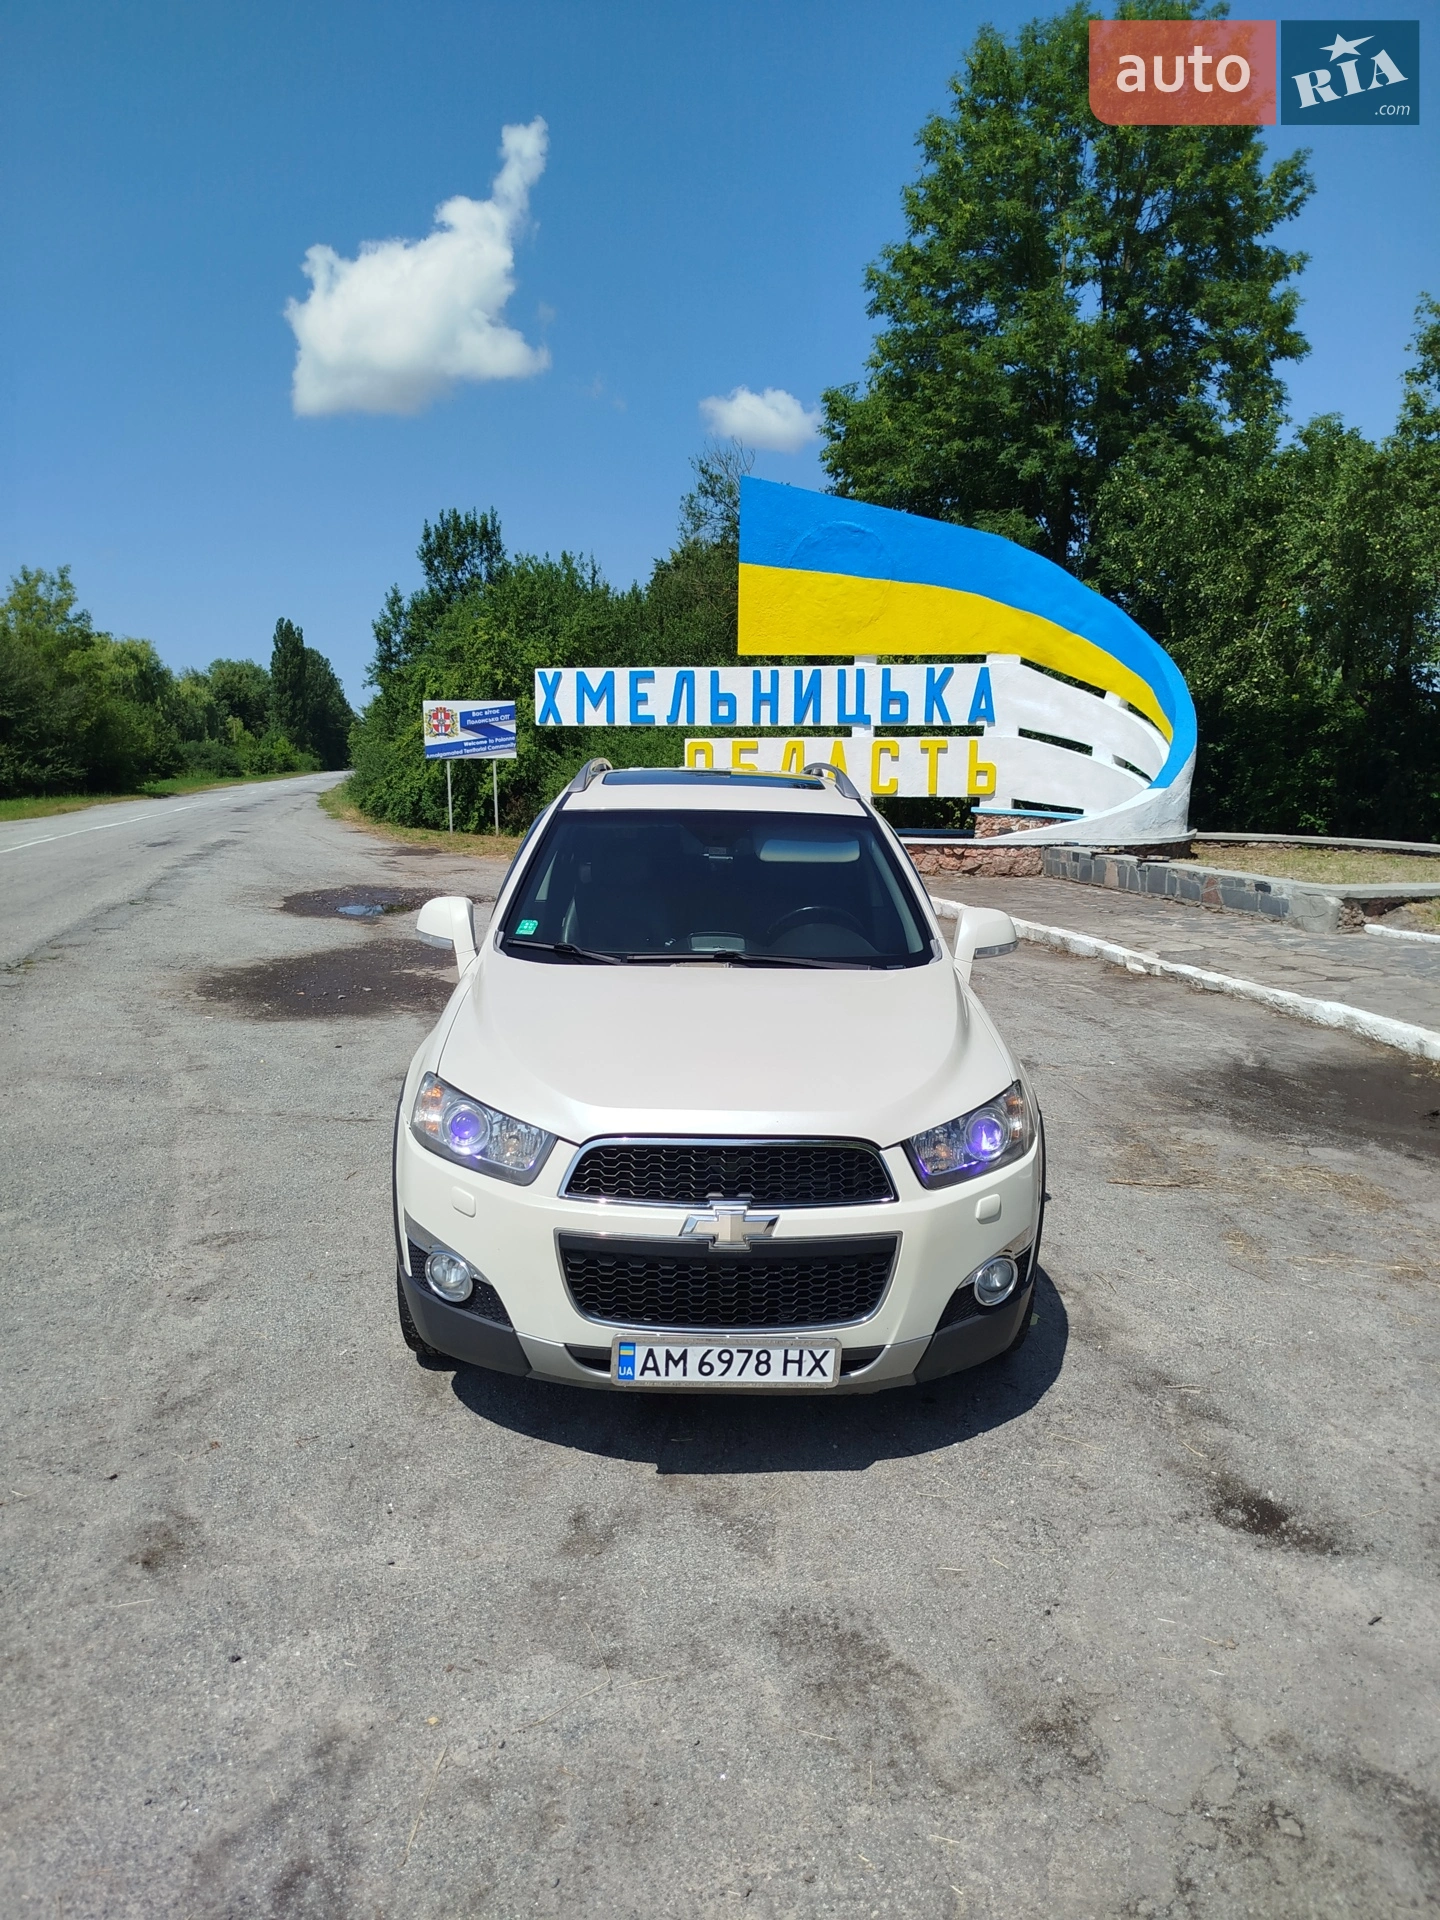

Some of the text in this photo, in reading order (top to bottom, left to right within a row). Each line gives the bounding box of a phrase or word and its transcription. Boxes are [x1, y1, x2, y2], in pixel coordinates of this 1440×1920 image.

[537, 666, 995, 725] ХМЕЛЬНИЦЬКА
[467, 717, 499, 725] Полонська
[426, 750, 463, 758] Amalgamated
[464, 746, 487, 754] Territorial
[619, 1348, 830, 1377] UA AM 6978 HX
